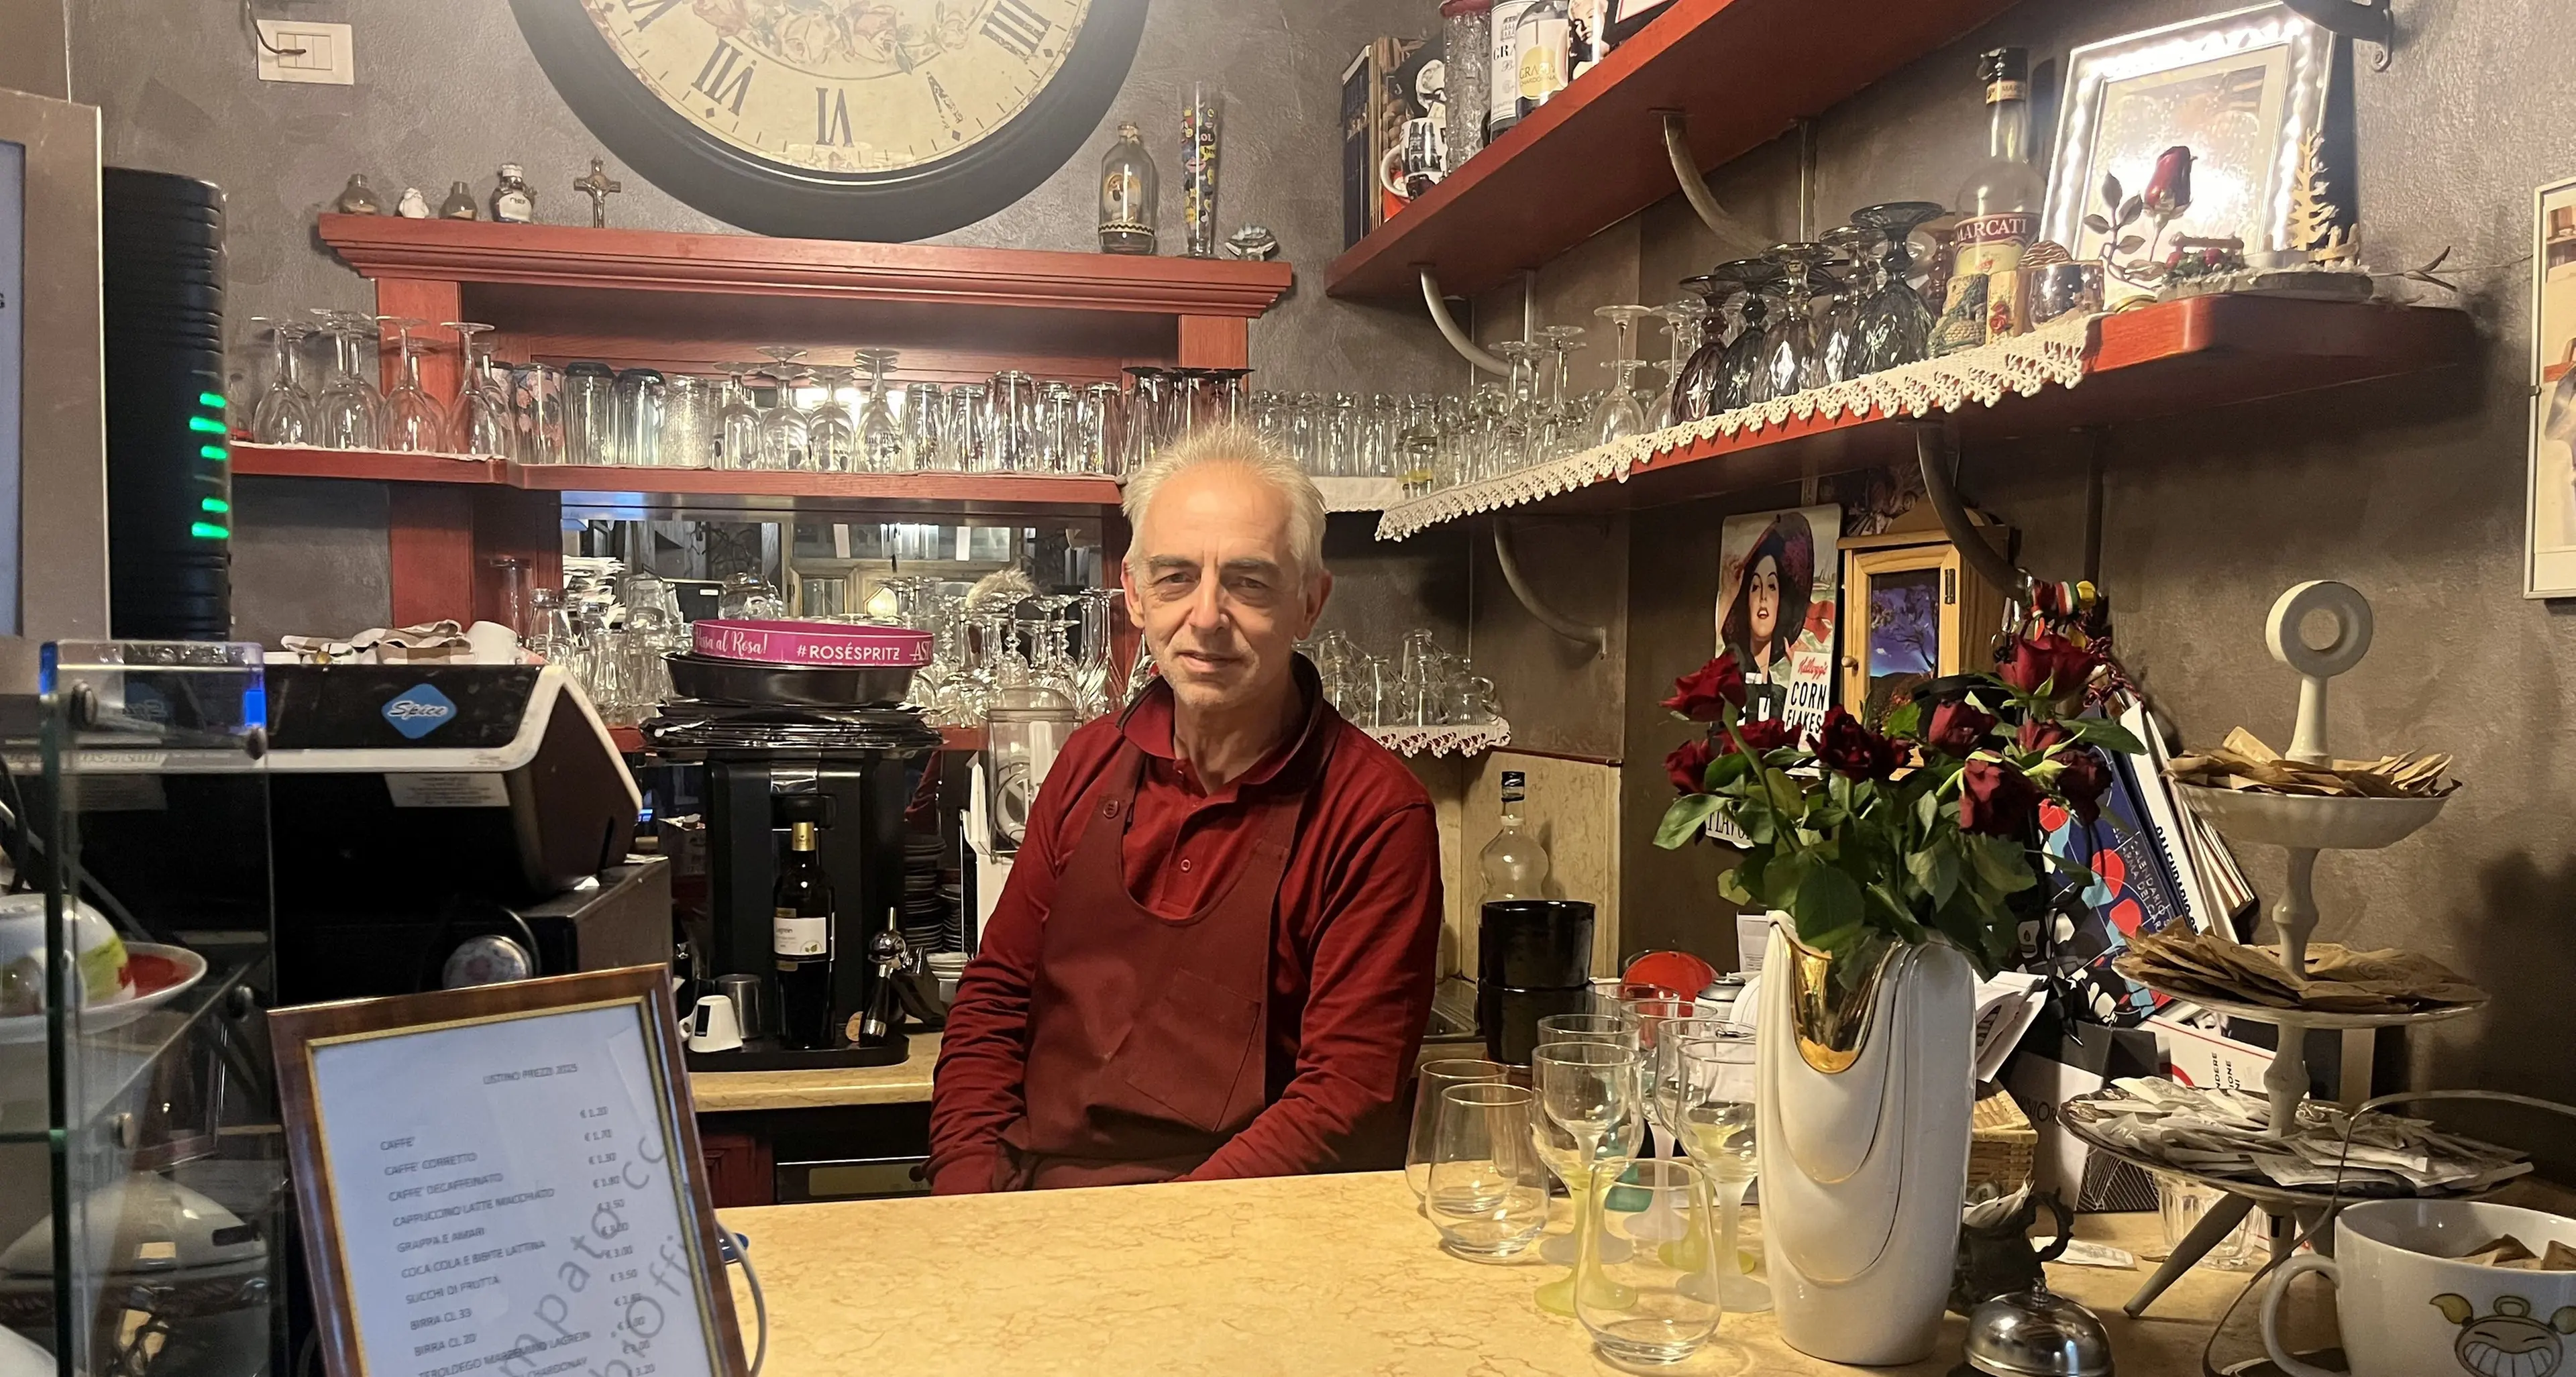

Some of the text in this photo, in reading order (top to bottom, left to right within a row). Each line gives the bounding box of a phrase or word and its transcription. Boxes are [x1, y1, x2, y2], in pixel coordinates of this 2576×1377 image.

[816, 87, 854, 148] VI
[1957, 219, 2027, 243] MARCATI
[731, 630, 768, 656] Rosa!
[1790, 681, 1827, 711] CORN
[387, 700, 448, 720] Spice
[1786, 709, 1821, 734] FLAKES
[401, 1264, 431, 1278] COCA
[433, 1258, 460, 1272] COLA
[405, 1287, 444, 1305] SUCCHI
[447, 1284, 458, 1295] DI
[460, 1275, 500, 1292] FRUTTA
[410, 1315, 440, 1331] BIRRA
[414, 1341, 445, 1357] BIRRA
